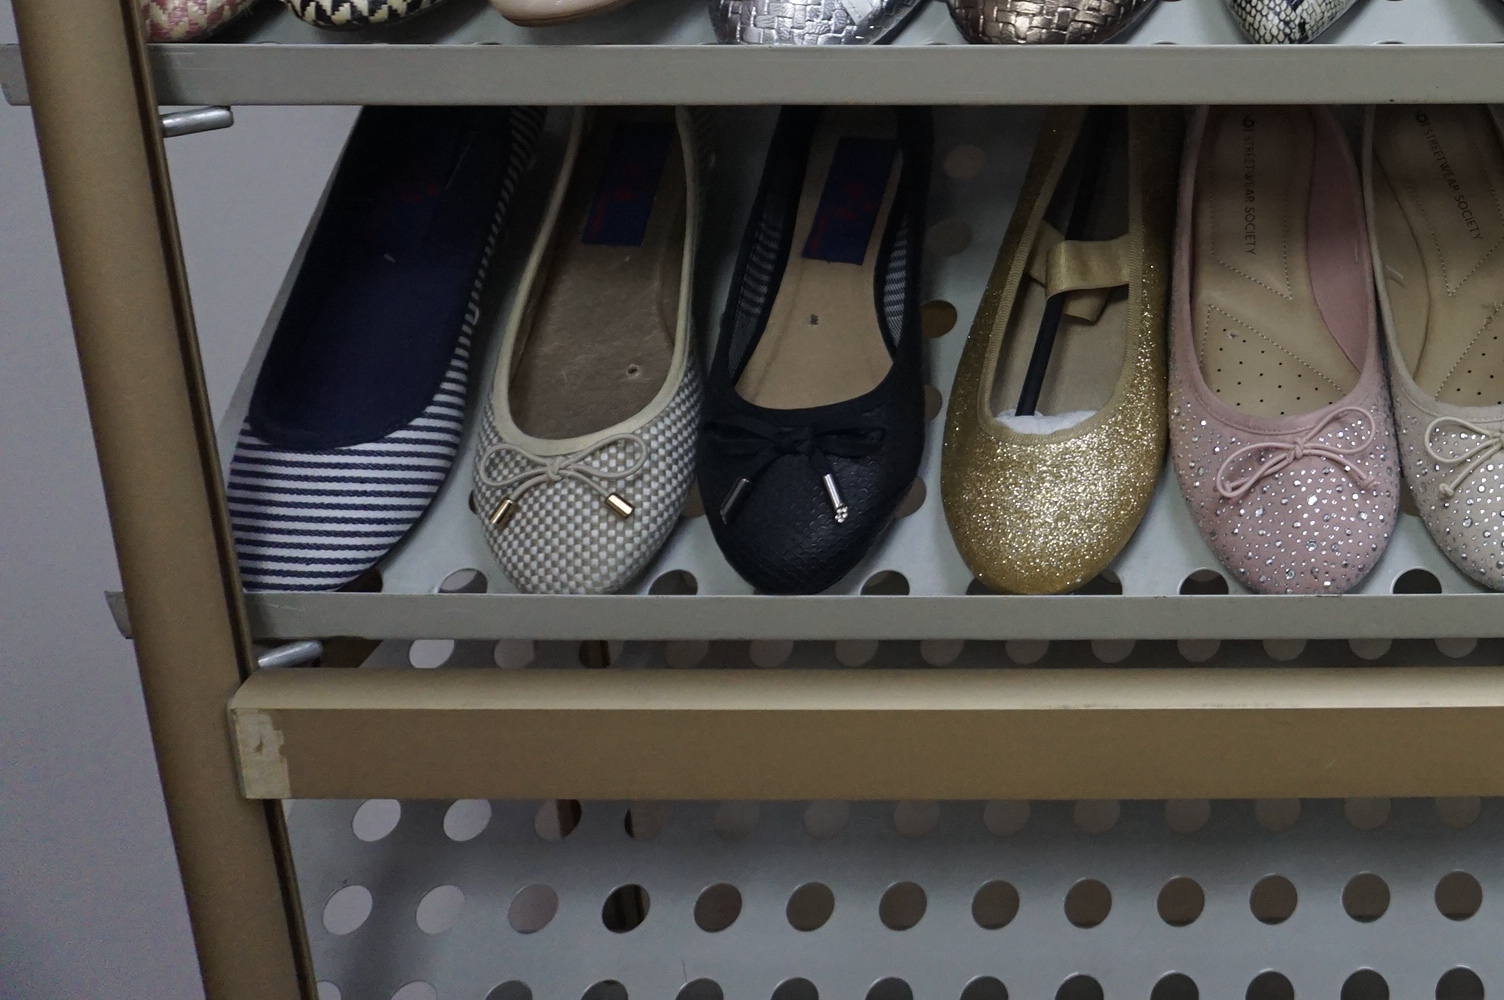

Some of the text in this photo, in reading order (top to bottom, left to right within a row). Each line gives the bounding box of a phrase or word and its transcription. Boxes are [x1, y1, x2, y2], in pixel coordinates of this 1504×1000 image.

[1244, 135, 1256, 255] STREETWEAR SOCIETY
[1423, 128, 1484, 241] STREETWEAR SOCIETY
